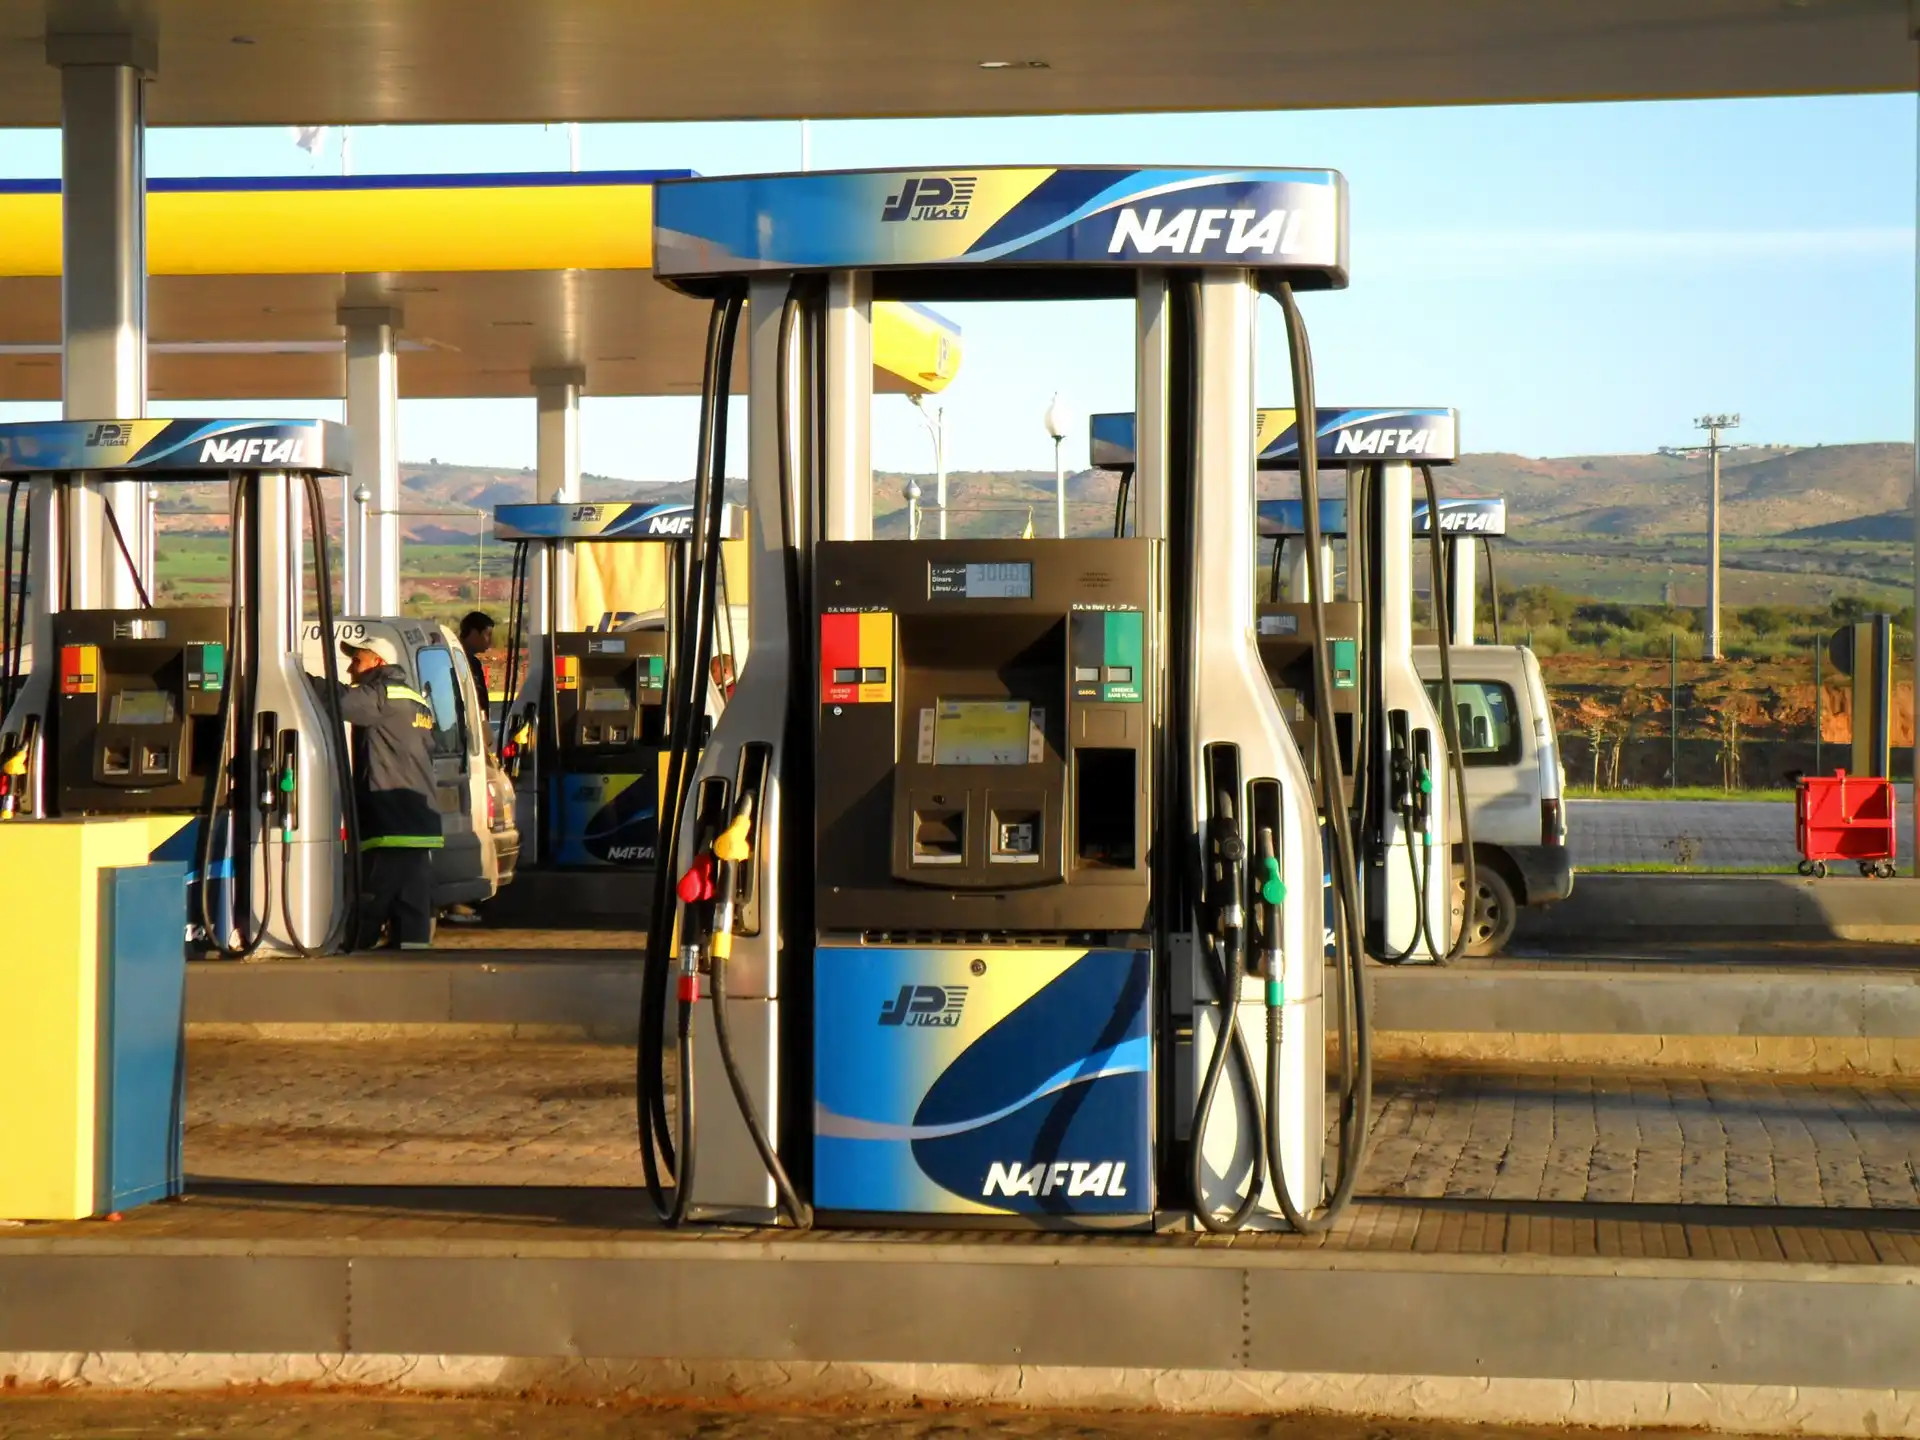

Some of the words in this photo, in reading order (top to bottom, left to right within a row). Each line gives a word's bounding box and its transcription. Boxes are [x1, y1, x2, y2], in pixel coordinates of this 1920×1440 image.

[199, 439, 305, 463] NAFTAL
[302, 624, 366, 640] /0/09
[982, 1161, 1127, 1197] NAFTAL
